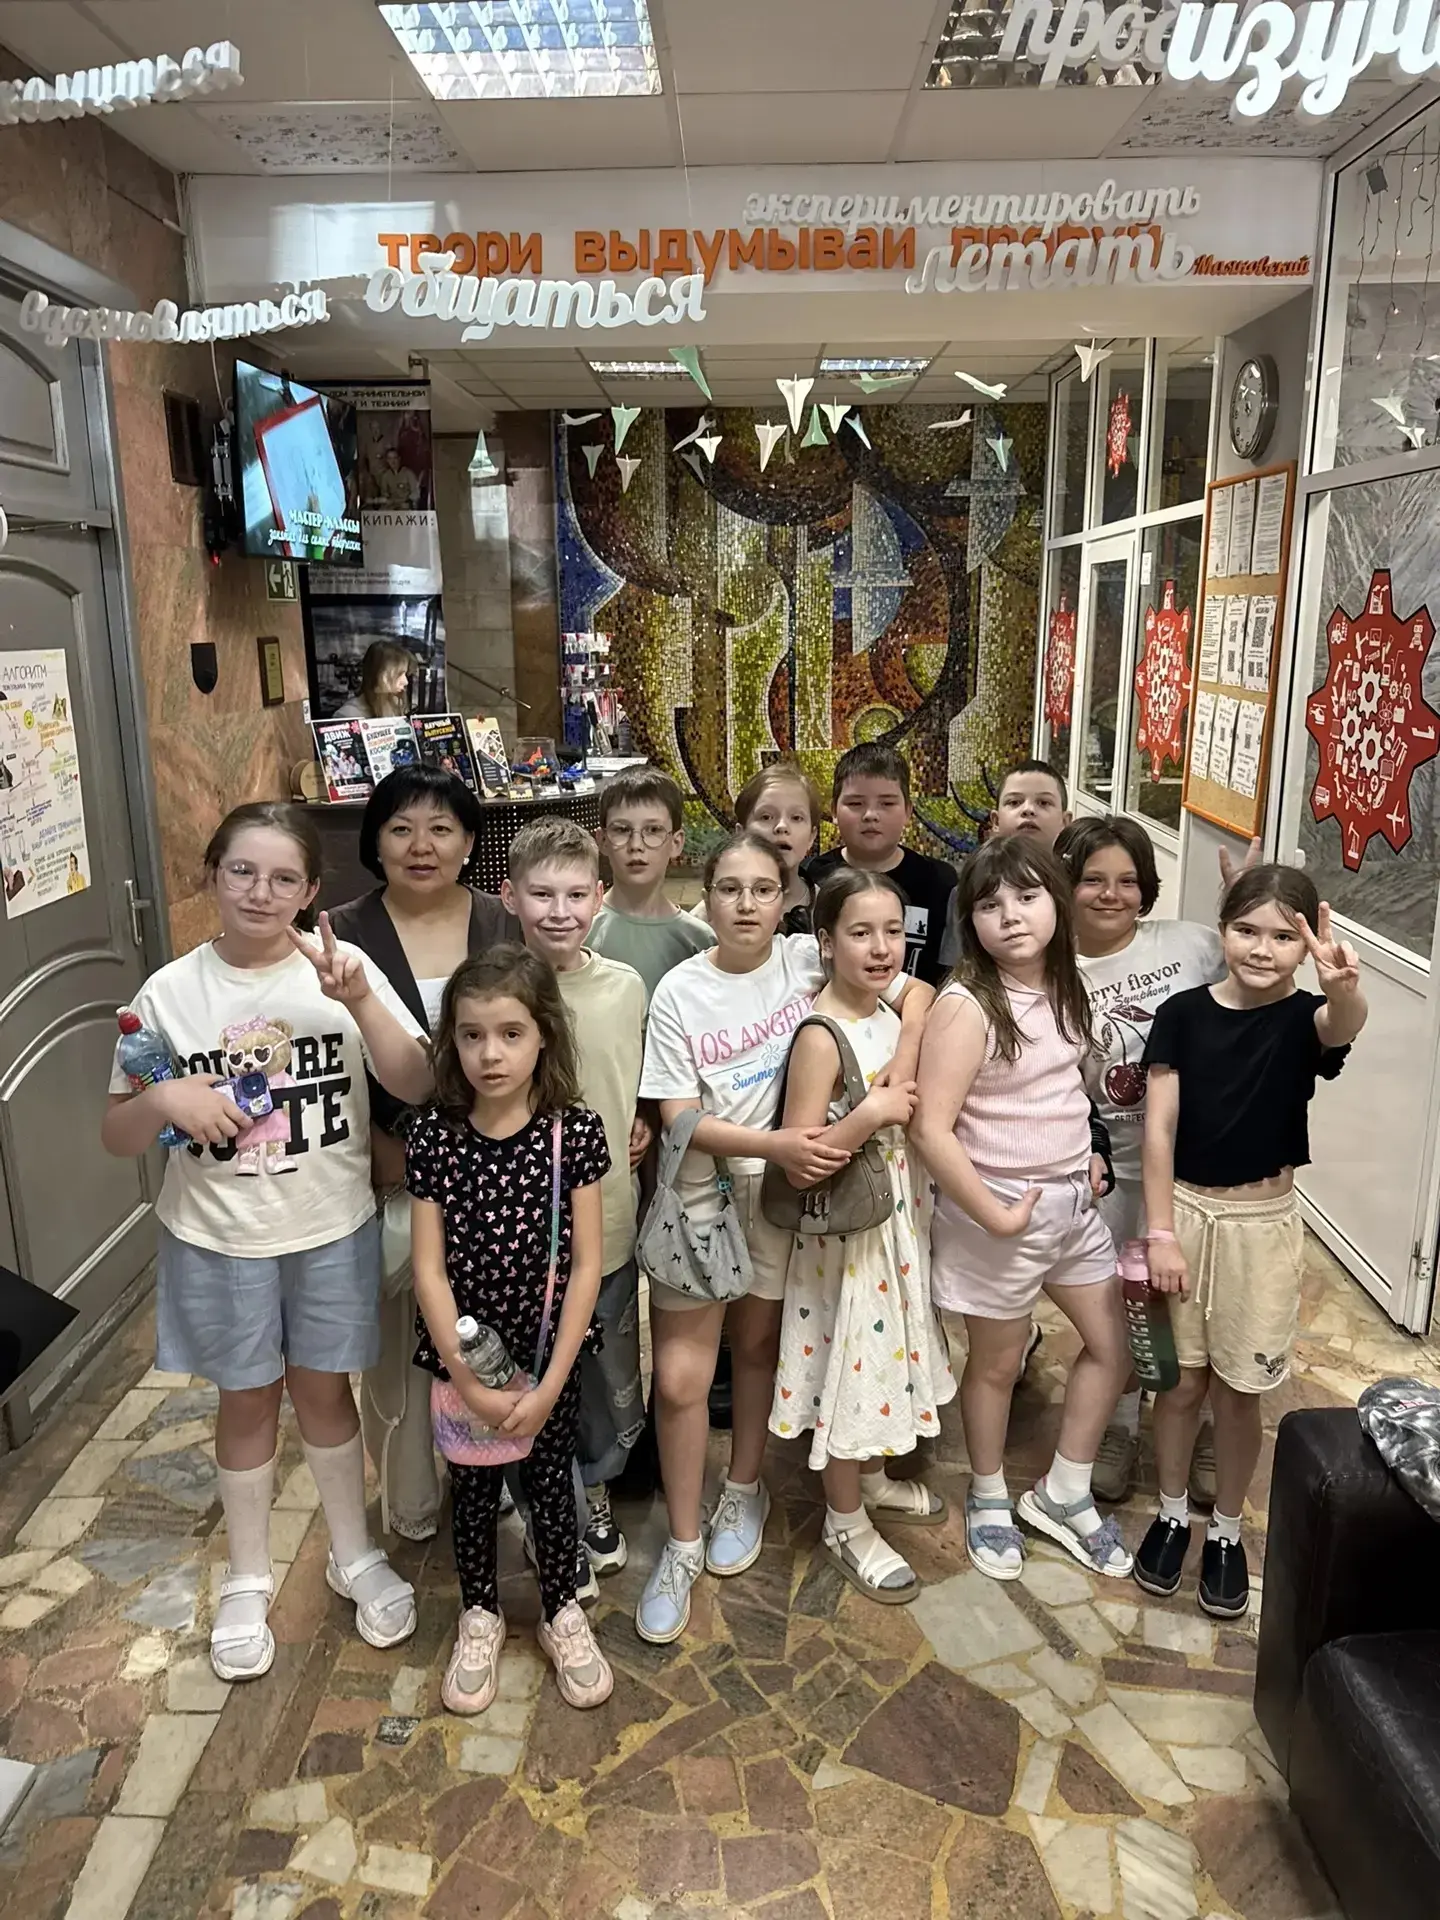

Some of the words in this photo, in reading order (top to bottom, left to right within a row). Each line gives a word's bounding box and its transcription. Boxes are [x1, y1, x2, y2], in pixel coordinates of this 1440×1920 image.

[743, 178, 1201, 245] экспериментировать
[378, 228, 543, 278] твори
[904, 231, 1197, 295] летать
[1192, 254, 1311, 276] Маяковский
[365, 250, 706, 343] общаться
[19, 290, 331, 348] вдохновляться
[362, 514, 435, 527] КИПАЖИ:
[3, 664, 48, 681] АЛГОРИТМ
[323, 730, 352, 744] ДВИЖ
[1088, 981, 1123, 1003] rry
[1127, 961, 1182, 992] flavor
[1112, 983, 1172, 1010] Symphony
[685, 1029, 733, 1072] LOS
[731, 1066, 779, 1091] Summer
